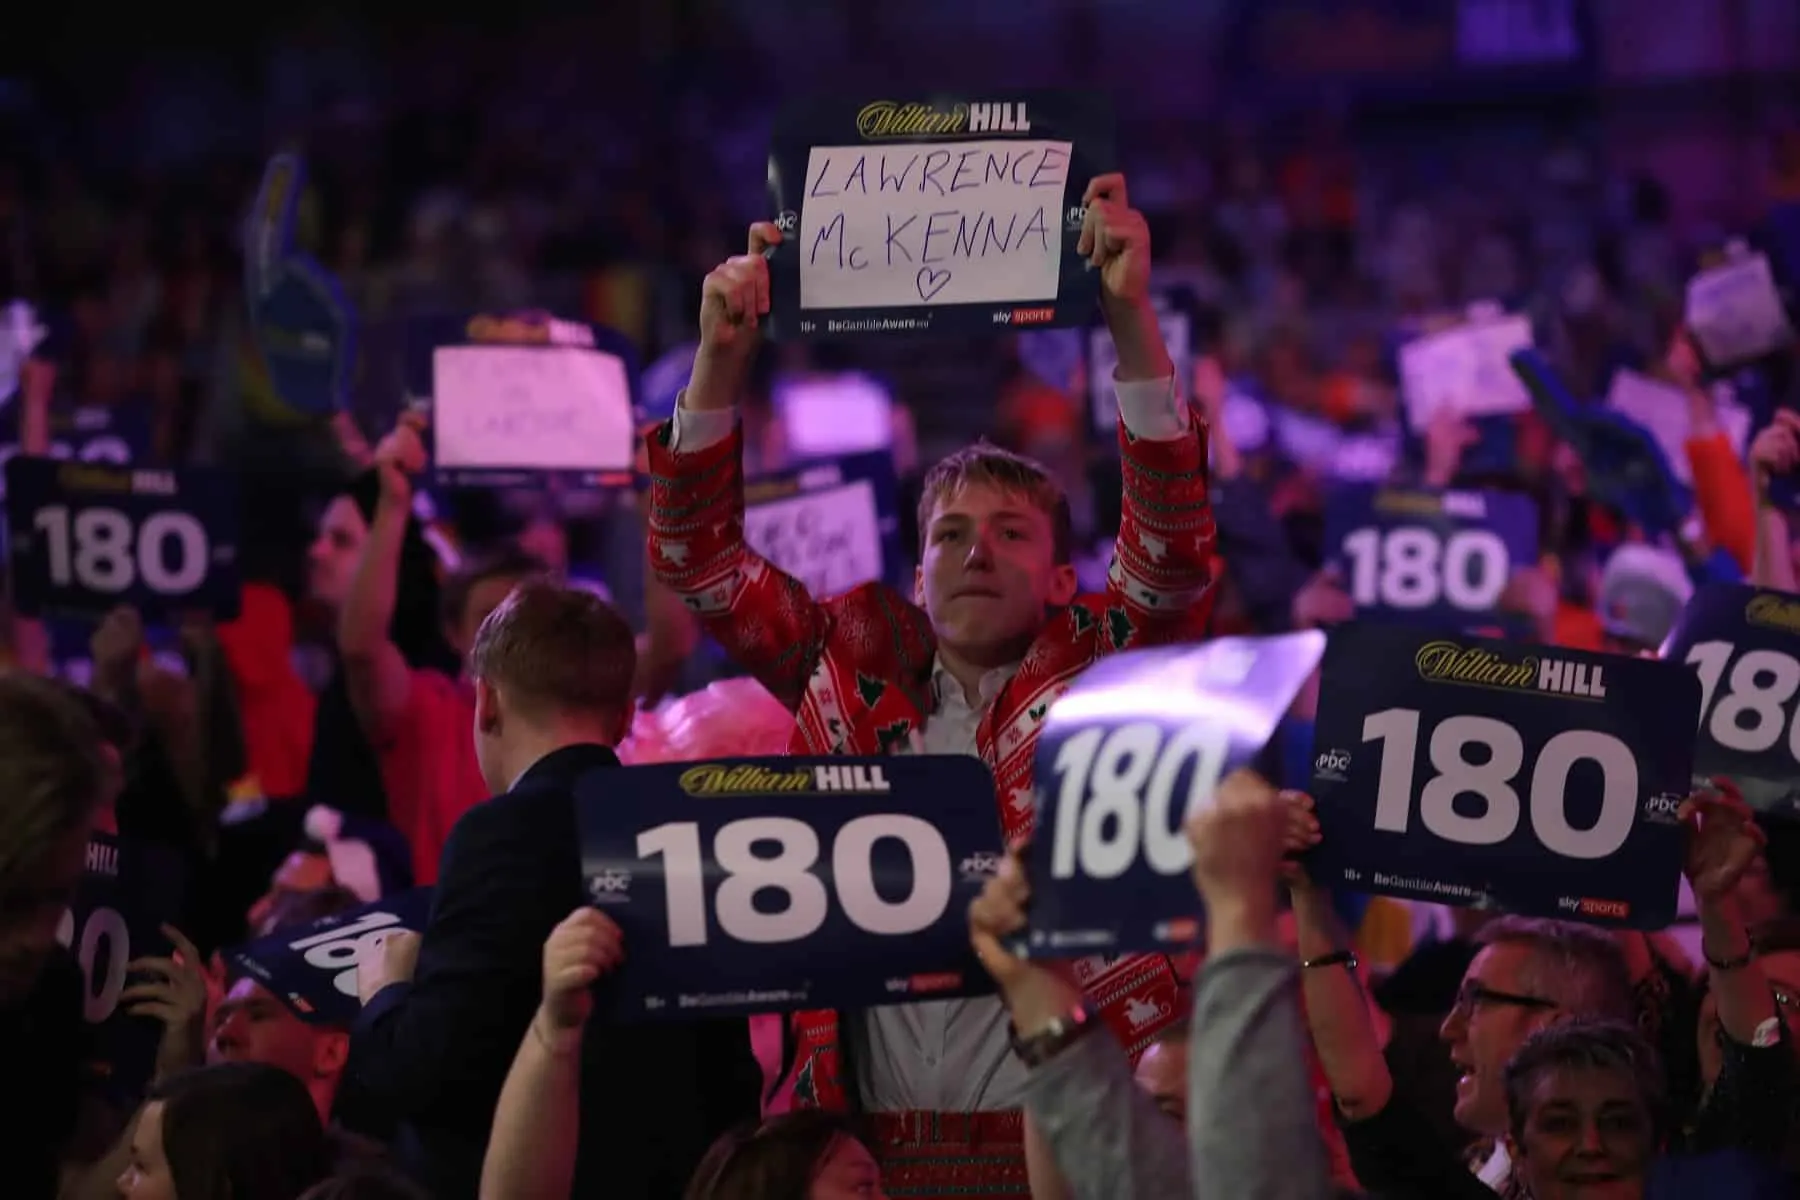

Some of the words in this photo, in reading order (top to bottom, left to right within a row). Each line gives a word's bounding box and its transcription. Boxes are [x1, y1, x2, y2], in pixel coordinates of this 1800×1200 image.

[856, 101, 967, 138] William
[968, 103, 1031, 131] HILL
[811, 149, 1069, 198] LAWRENCE
[992, 310, 1011, 325] sky
[1015, 309, 1053, 323] sports
[33, 503, 210, 595] 180
[1342, 525, 1509, 610] 180
[1415, 640, 1539, 690] William
[1537, 656, 1607, 698] HILL
[1685, 640, 1800, 764] 18
[678, 762, 812, 798] William
[815, 764, 890, 791] HILL
[1316, 749, 1351, 770] PDC
[1361, 706, 1640, 860] 180
[635, 812, 952, 948] 180
[1558, 896, 1580, 911] sky
[1582, 901, 1626, 916] sports
